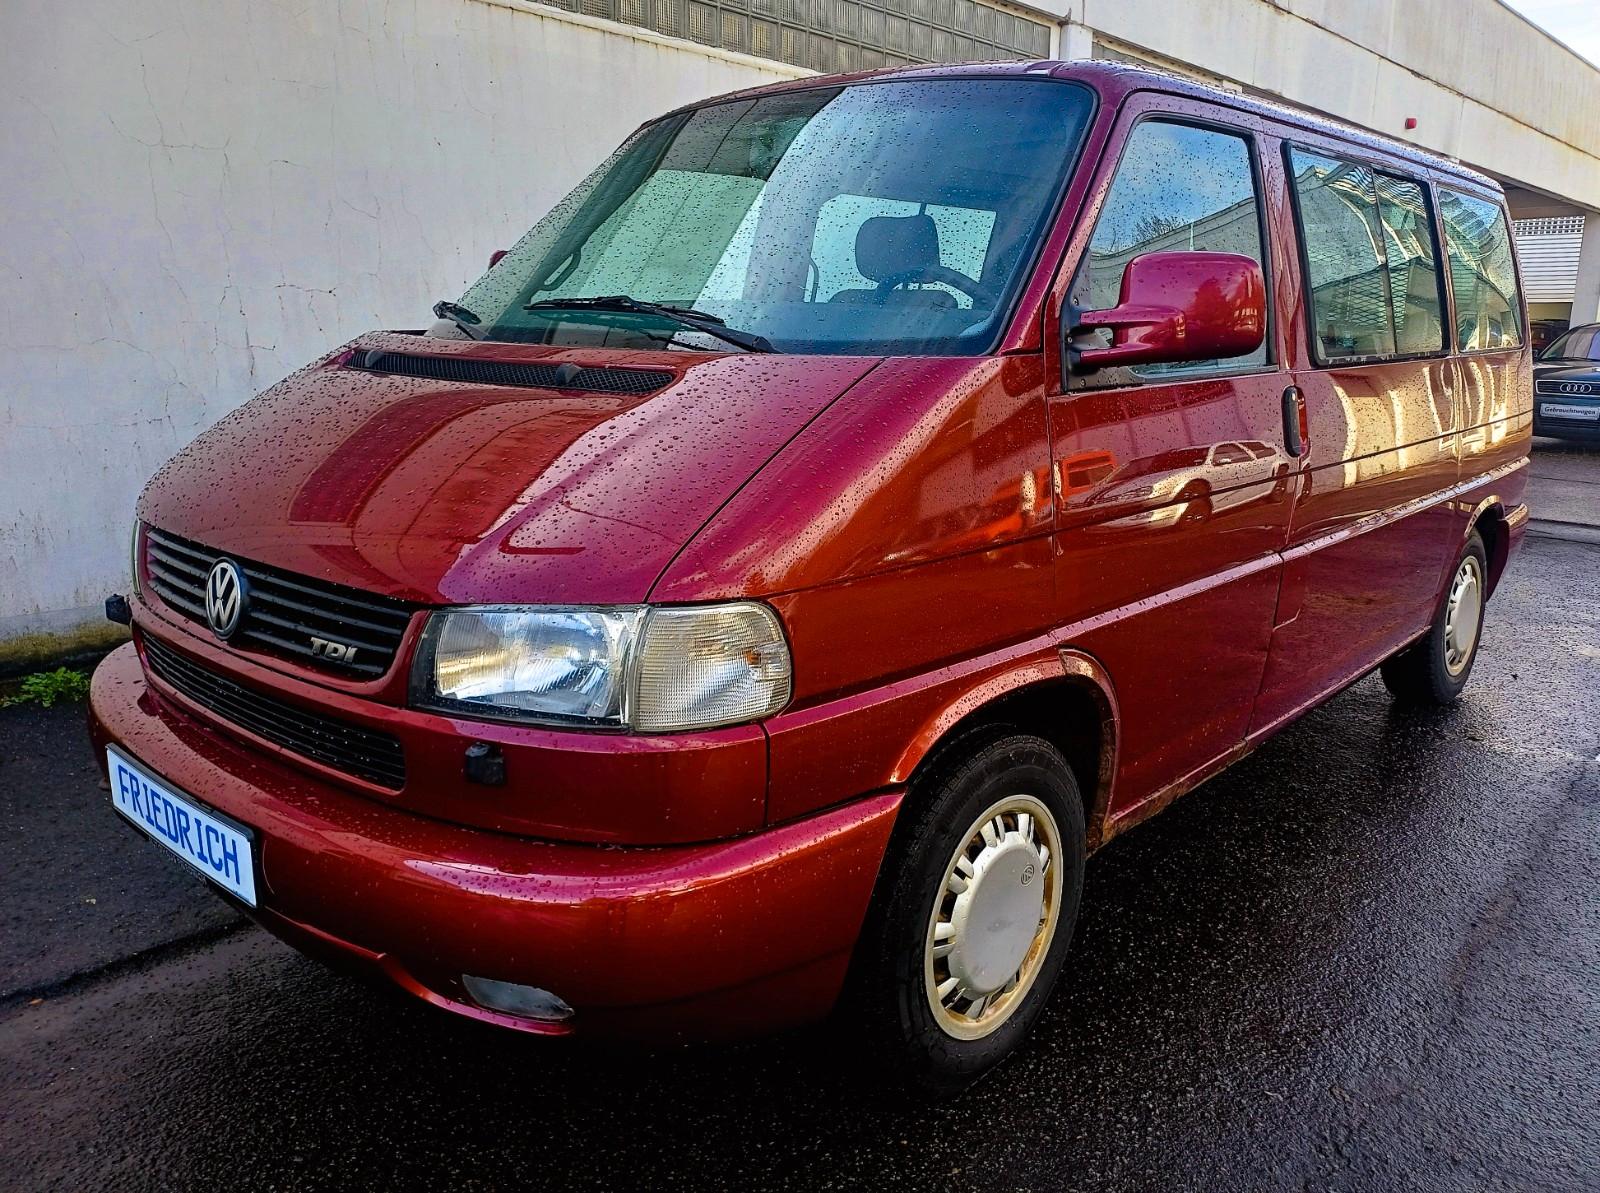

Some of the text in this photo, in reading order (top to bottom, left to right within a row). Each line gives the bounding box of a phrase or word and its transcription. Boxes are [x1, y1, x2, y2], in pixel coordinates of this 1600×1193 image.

[1544, 406, 1596, 416] Gebrauchtwagen
[310, 636, 358, 663] TDI
[118, 765, 241, 885] FRIEDRICH
